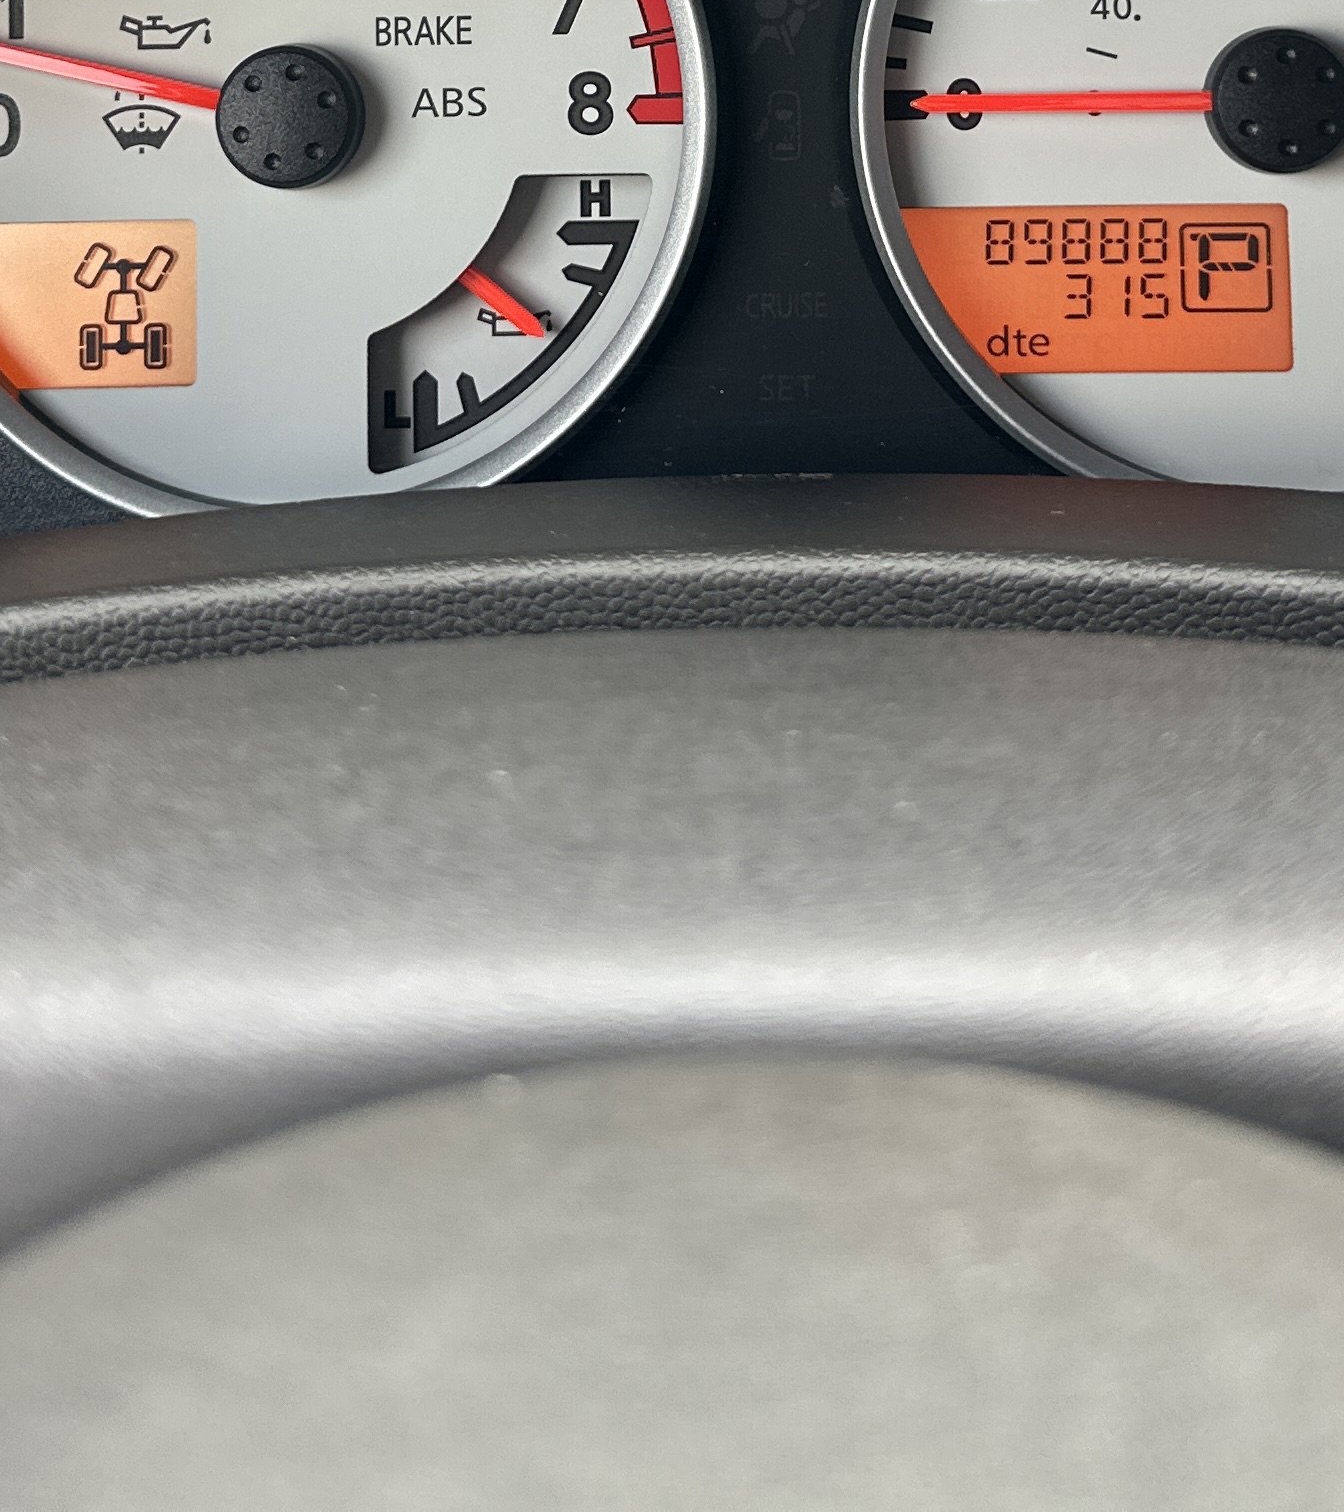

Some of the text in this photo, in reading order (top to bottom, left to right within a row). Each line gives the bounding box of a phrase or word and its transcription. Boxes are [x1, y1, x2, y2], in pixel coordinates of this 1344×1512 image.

[375, 15, 473, 47] BRAKE
[411, 86, 487, 119] ABS
[567, 70, 614, 136] 8
[580, 179, 611, 217] H
[985, 217, 1168, 266] 89888
[1189, 232, 1260, 302] P
[1064, 272, 1170, 320] 315
[986, 324, 1050, 357] dte
[383, 389, 411, 429] L
